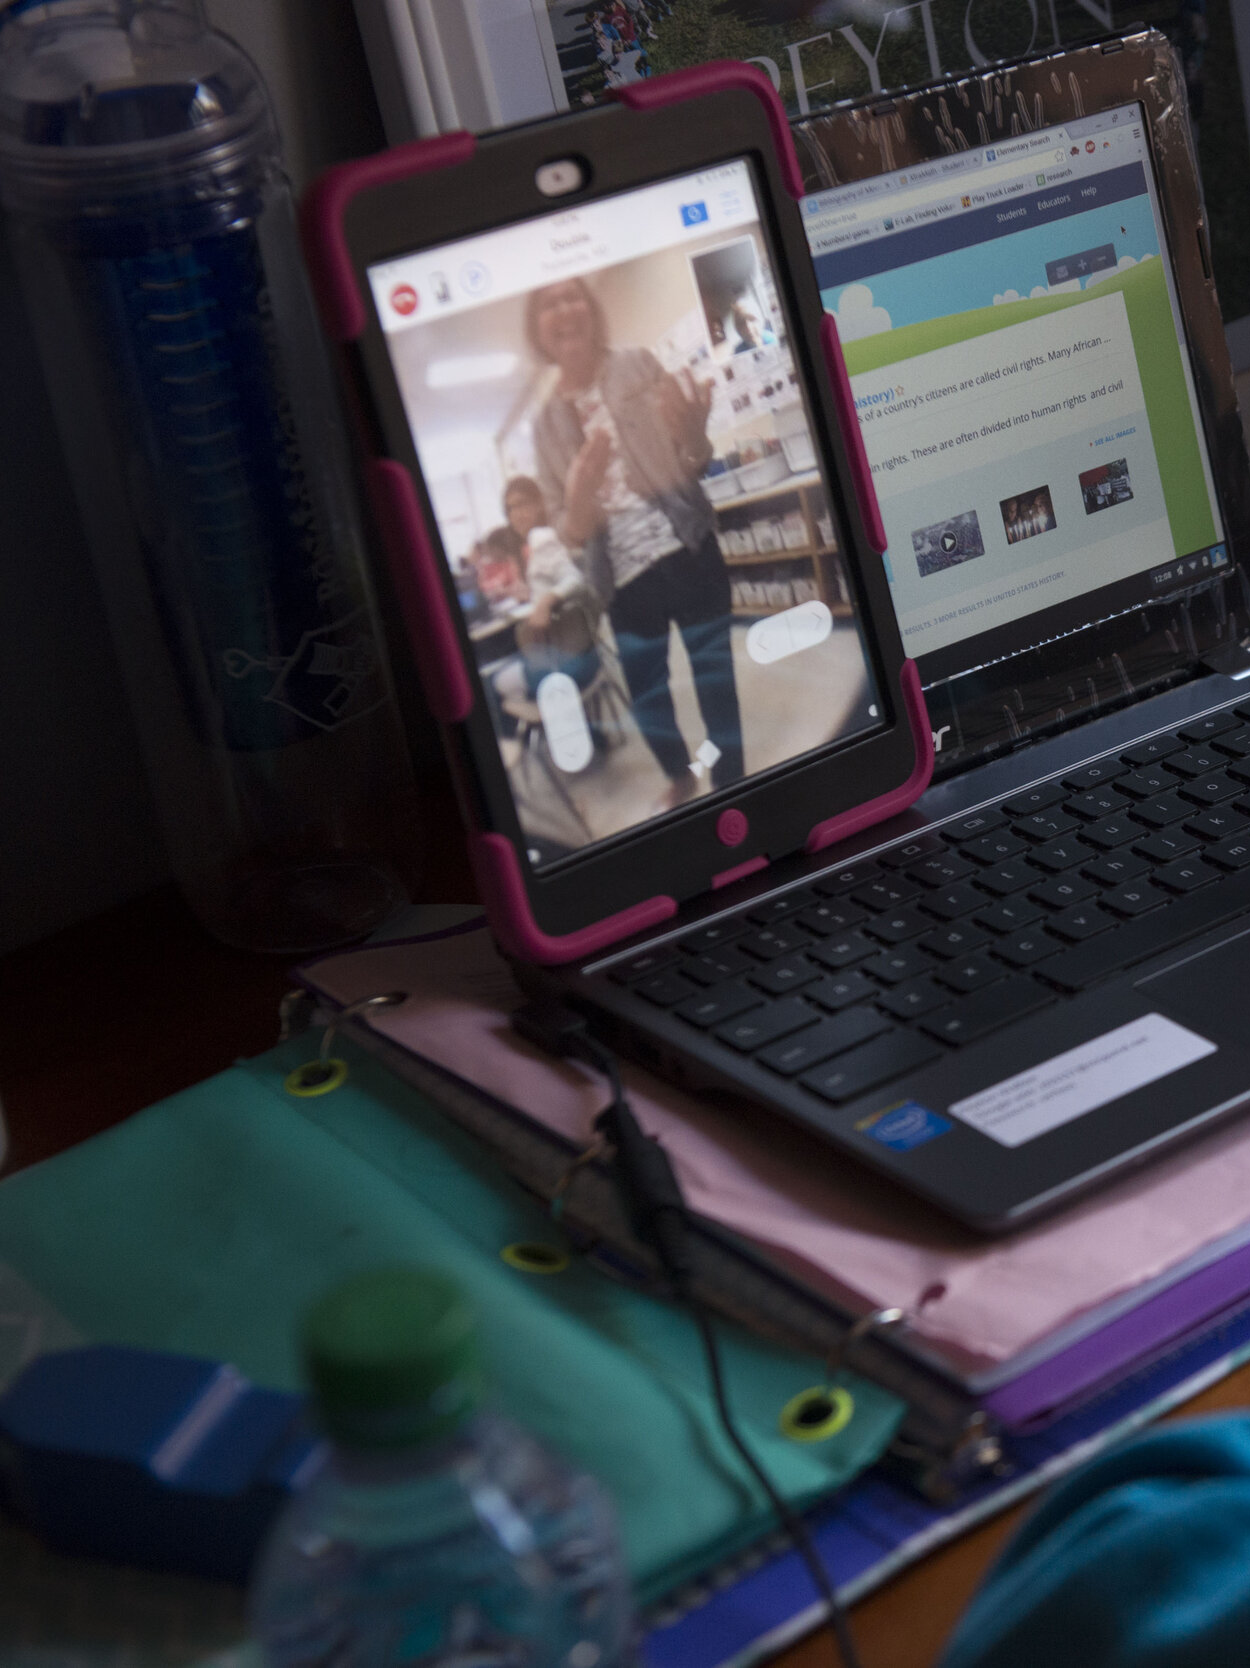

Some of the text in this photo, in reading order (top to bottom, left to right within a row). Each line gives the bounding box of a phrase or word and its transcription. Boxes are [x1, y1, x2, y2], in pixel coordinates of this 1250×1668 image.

[996, 136, 1050, 156] Elementary Search
[1047, 168, 1073, 182] research
[971, 182, 1024, 204] Play Truck Loader
[996, 186, 1097, 223] Students Educators Help
[865, 409, 876, 422] of
[876, 409, 883, 418] a
[883, 394, 925, 416] country's
[925, 384, 958, 403] citizens
[959, 379, 974, 392] are
[975, 367, 1001, 387] called
[1001, 362, 1019, 378] civil
[1019, 353, 1047, 373] rights.
[1047, 347, 1072, 365] Many
[1072, 336, 1103, 354] African
[881, 453, 910, 474] rights.
[911, 443, 938, 462] These
[939, 438, 954, 452] are
[955, 428, 979, 446] often
[980, 418, 1012, 439] divided
[1013, 412, 1030, 429] into
[1031, 402, 1062, 421] human
[1062, 393, 1087, 413] rights
[1090, 387, 1106, 401] and
[1107, 379, 1124, 395] civil
[1094, 426, 1137, 447] SEE ALL IMAGES
[938, 609, 958, 623] MORE
[957, 600, 985, 617] RESULTS
[993, 588, 1016, 604] UNITED
[1016, 580, 1039, 597] STATES
[1039, 571, 1065, 590] HISTORY
[1228, 845, 1248, 856] m
